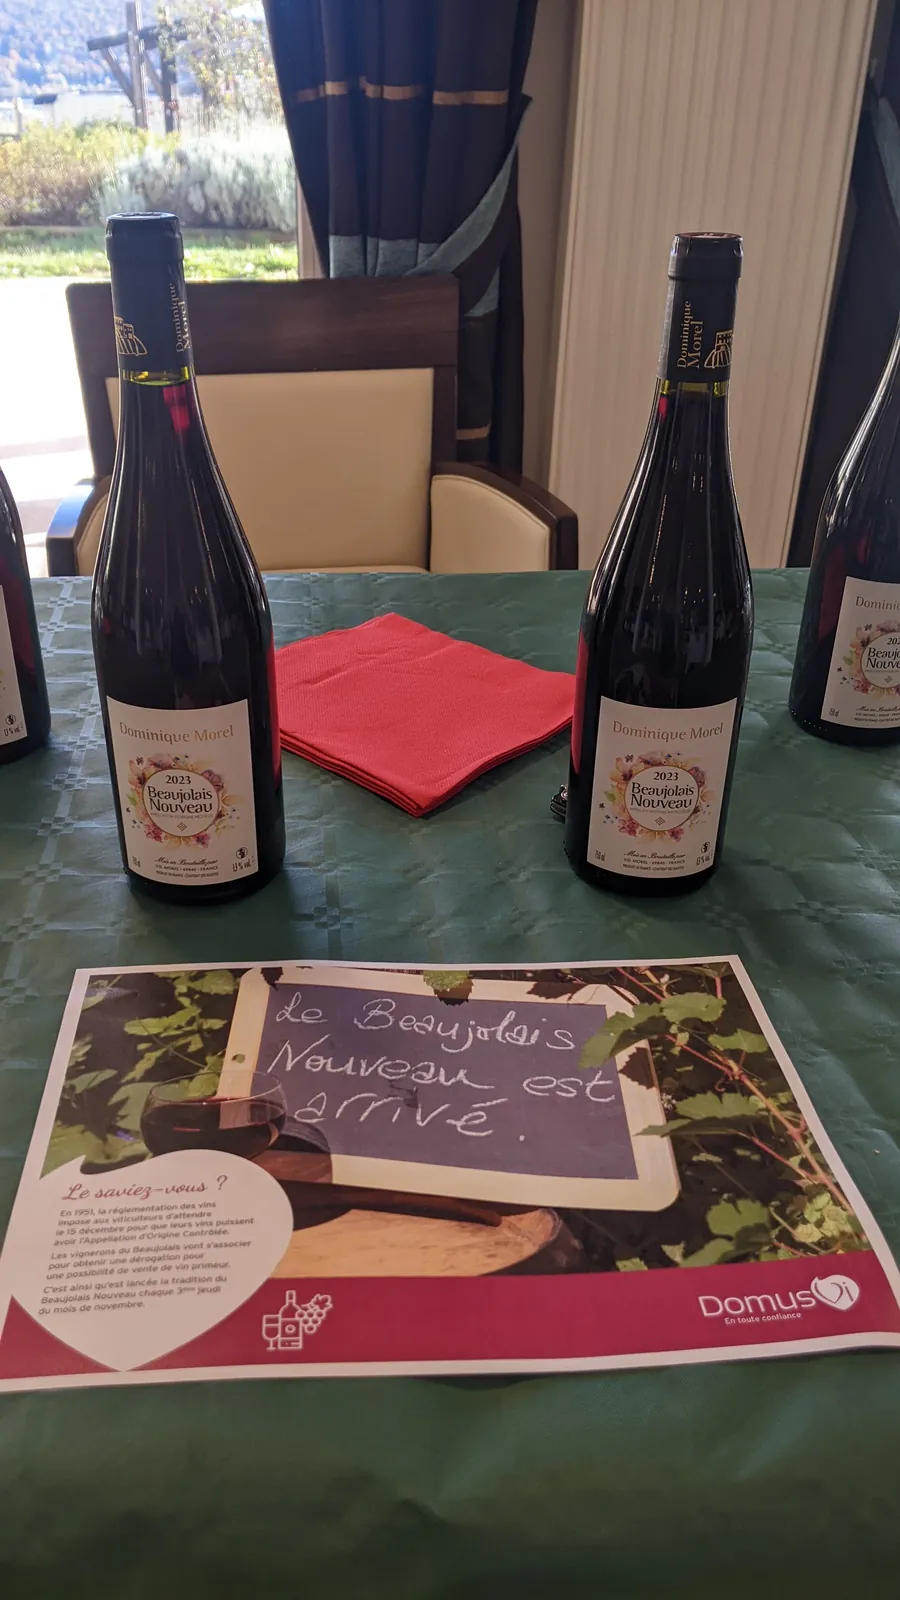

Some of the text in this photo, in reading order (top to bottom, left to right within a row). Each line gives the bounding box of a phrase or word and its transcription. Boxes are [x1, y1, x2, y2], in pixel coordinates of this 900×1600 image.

[170, 282, 184, 352] Dominique
[178, 301, 191, 349] Morel
[677, 300, 693, 368] Dominique
[687, 321, 703, 369] Morel
[119, 721, 234, 745] Dominique Morel
[612, 720, 724, 742] Dominique Morel
[165, 775, 191, 785] 2023
[653, 771, 679, 781] 2023
[147, 786, 212, 803] Beaujolais
[631, 782, 694, 799] Beaujolais
[149, 798, 212, 813] Nouveau
[631, 794, 692, 809] Nouveau
[276, 991, 575, 1054] Le Beaujolais
[266, 1033, 616, 1102] Nouveau est
[62, 1175, 228, 1200] Le saviez-vous ?
[58, 1218, 91, 1226] impose
[112, 1214, 163, 1223] viticulteurs
[165, 1211, 212, 1220] d'attendre
[60, 1209, 72, 1217] En
[74, 1208, 96, 1217] 1951,
[108, 1203, 178, 1215] réglementation
[180, 1202, 196, 1210] des
[198, 1201, 217, 1209] vins
[56, 1228, 64, 1236] le
[79, 1226, 125, 1235] décembre
[127, 1224, 149, 1233] pour
[150, 1222, 168, 1231] que
[170, 1221, 193, 1229] leurs
[195, 1219, 213, 1227] vins
[215, 1217, 255, 1227] puissent
[53, 1228, 230, 1246] avoir l'Appellation d'Origine Contrôlée.
[51, 1240, 252, 1260] Les vignerons du Beaujolais vont s'associer
[46, 1261, 231, 1280] une possibilité de vente de vin primeur.
[48, 1252, 205, 1271] pour obtenir une dérogation pour
[43, 1274, 228, 1294] C'est ainsi qu'est lancée la tradition du
[41, 1293, 91, 1304] Beaujolais
[93, 1290, 137, 1300] Nouveau
[138, 1288, 174, 1298] chaque
[197, 1286, 221, 1295] jeudi
[38, 1301, 145, 1315] du mois de novembre.
[724, 1311, 802, 1325] En toute confiance
